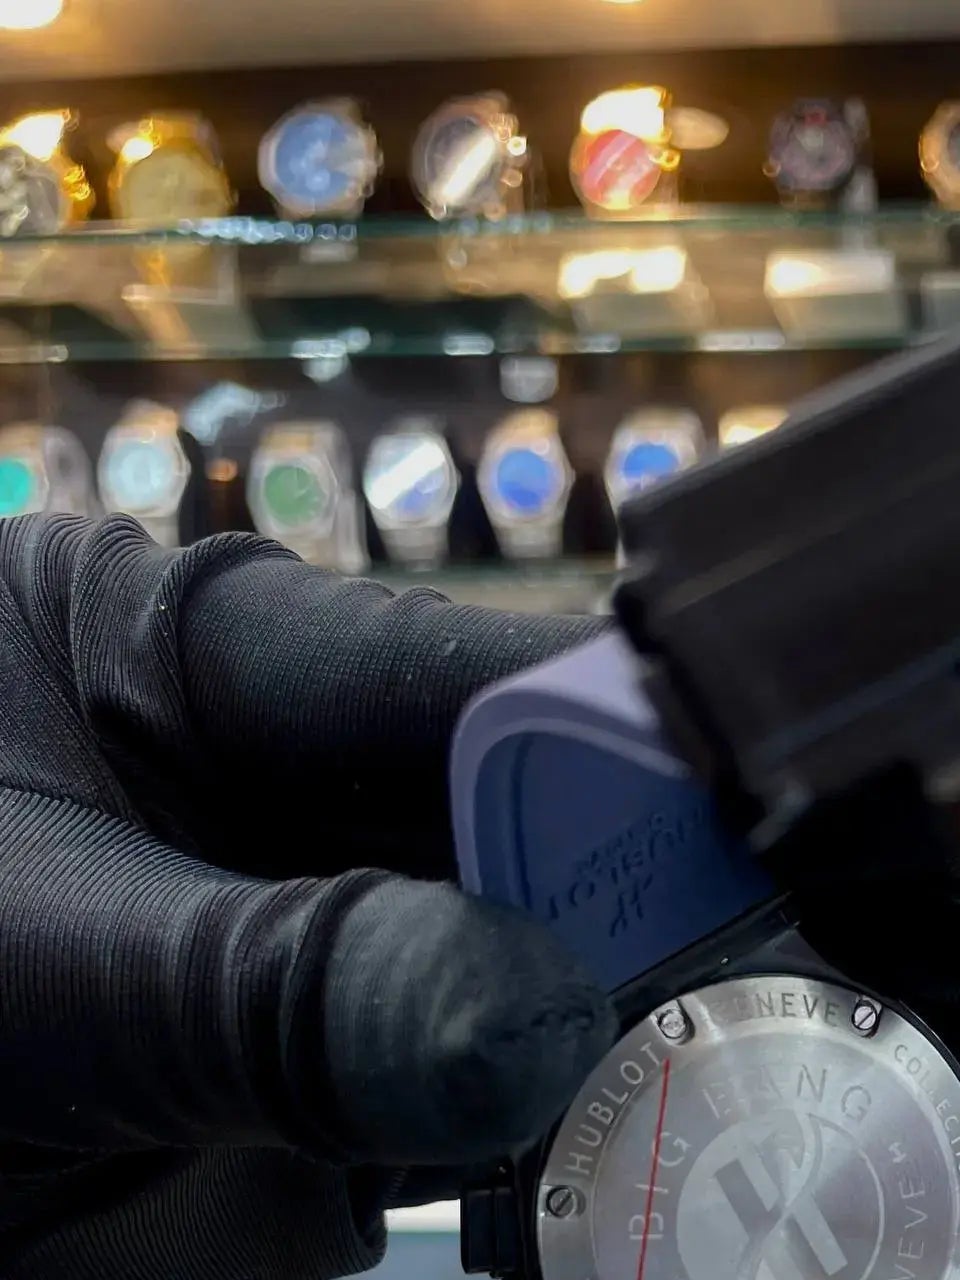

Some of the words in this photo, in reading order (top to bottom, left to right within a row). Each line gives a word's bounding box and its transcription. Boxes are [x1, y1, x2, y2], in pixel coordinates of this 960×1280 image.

[565, 1042, 660, 1175] HUBLOT
[707, 991, 841, 1027] ENEVE
[628, 1131, 692, 1240] BIG
